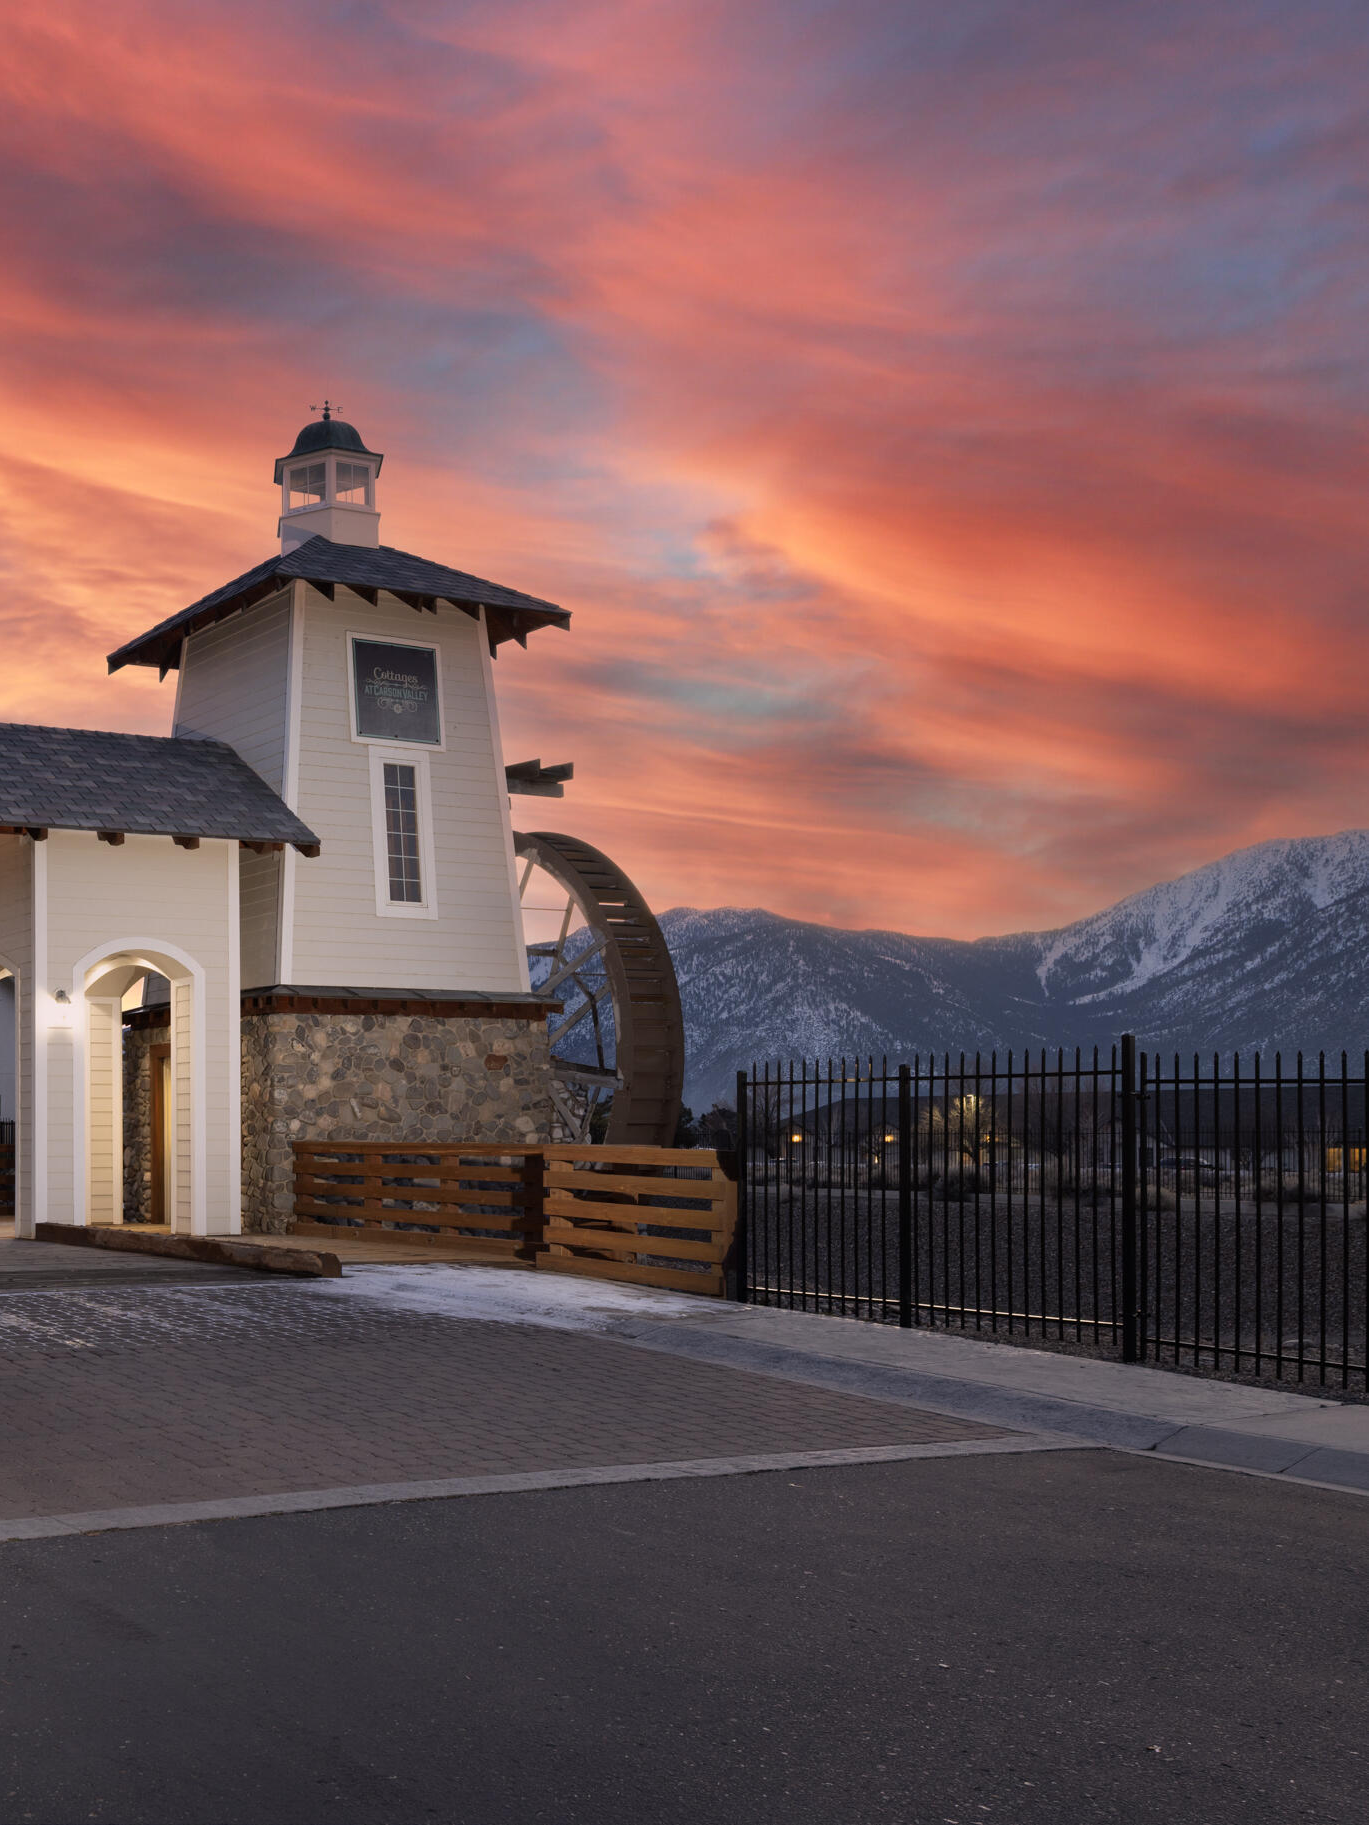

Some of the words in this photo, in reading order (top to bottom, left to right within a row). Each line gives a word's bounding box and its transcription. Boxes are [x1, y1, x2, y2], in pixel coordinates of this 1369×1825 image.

[373, 666, 418, 688] Cottages
[364, 685, 374, 694] AT
[374, 685, 403, 698] CARSON
[403, 689, 429, 702] VALLEY
